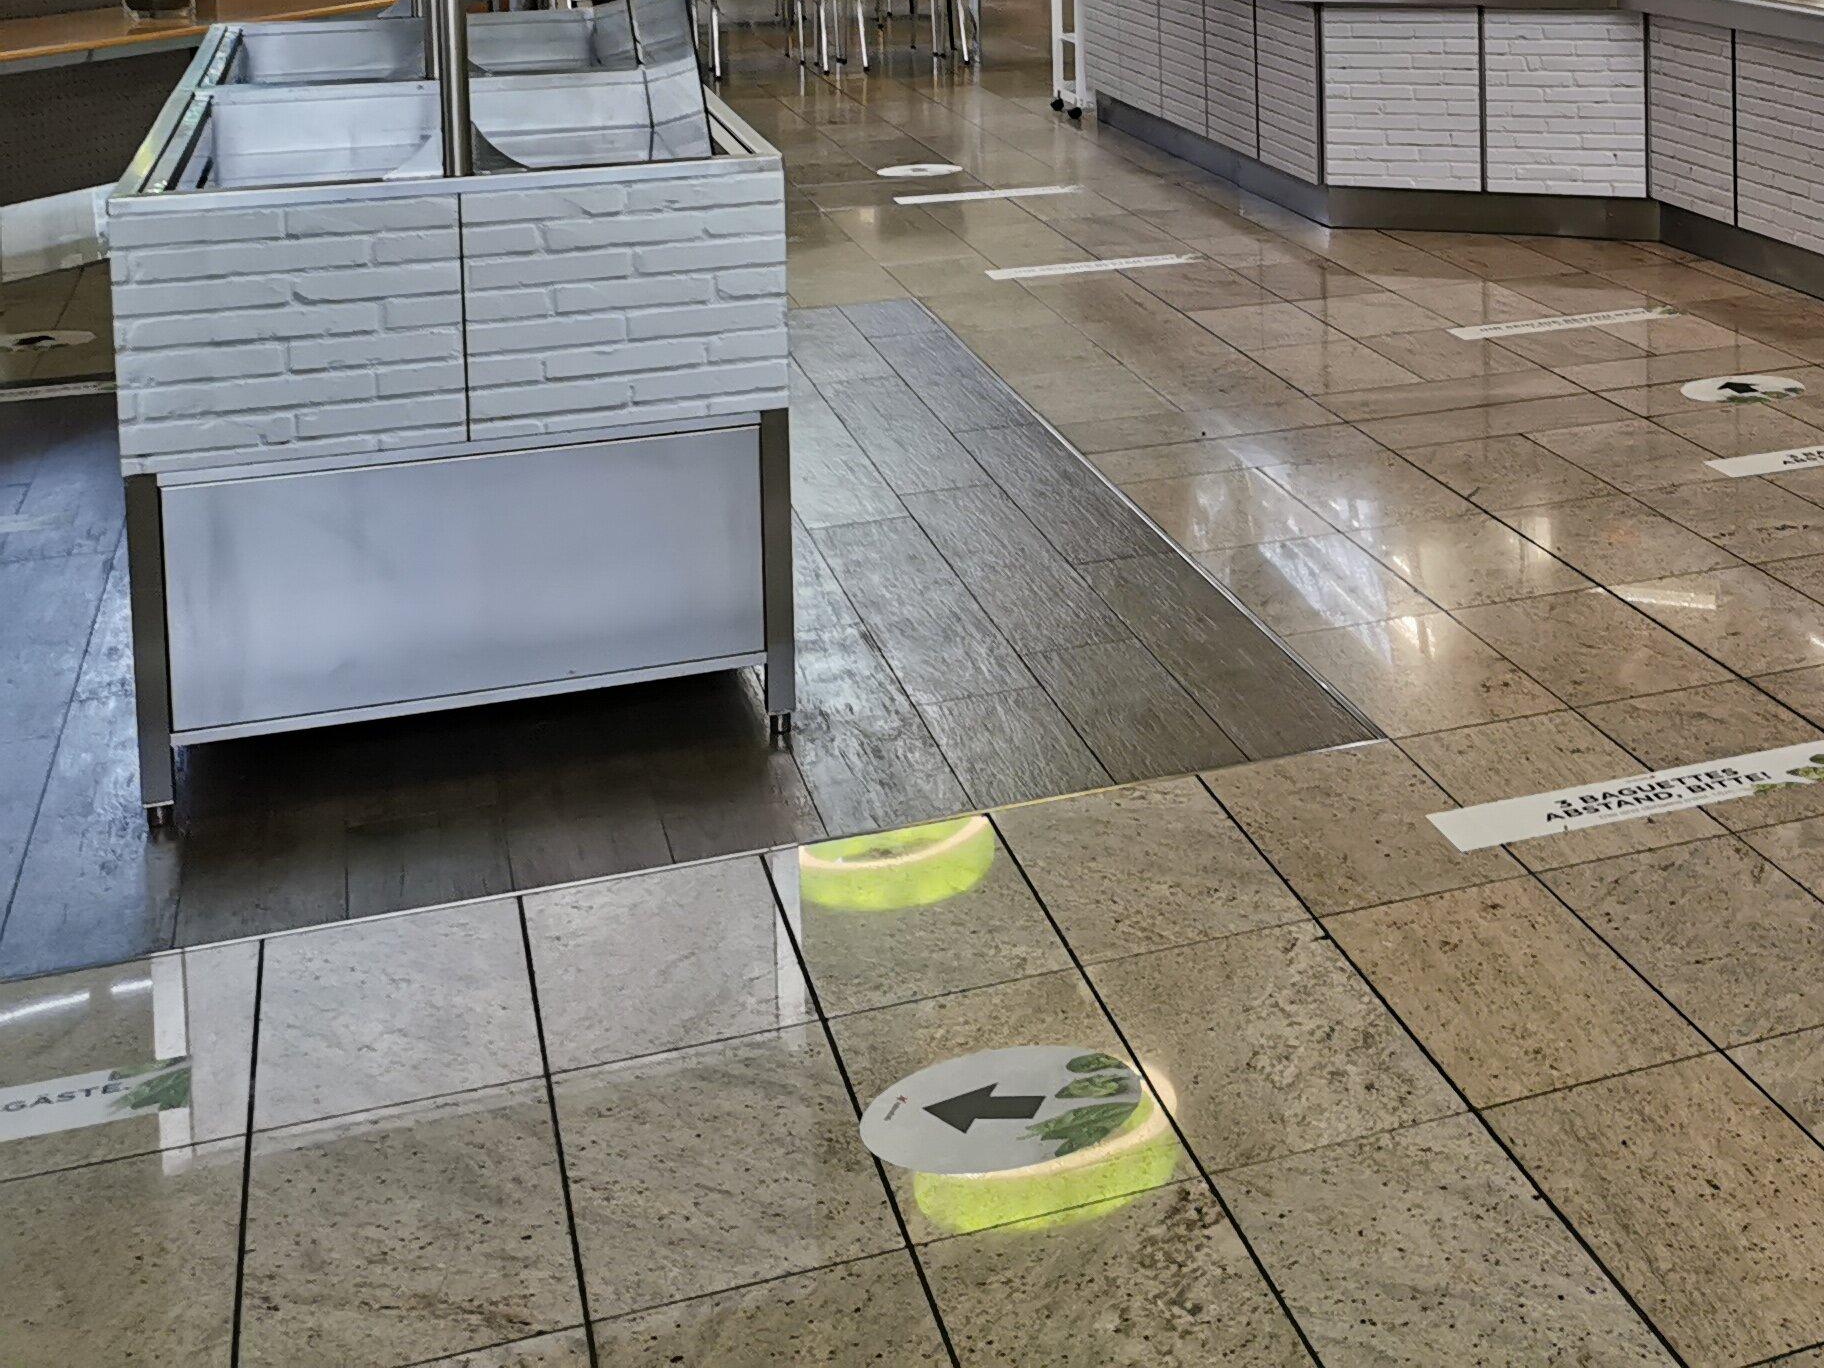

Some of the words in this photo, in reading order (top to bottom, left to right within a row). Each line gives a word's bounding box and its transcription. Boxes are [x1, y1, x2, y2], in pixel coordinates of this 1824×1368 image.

[1546, 791, 1683, 822] ABSTAND,
[1686, 771, 1772, 794] BITTE!
[1554, 799, 1572, 809] 3
[1579, 767, 1740, 804] BAGUETTES
